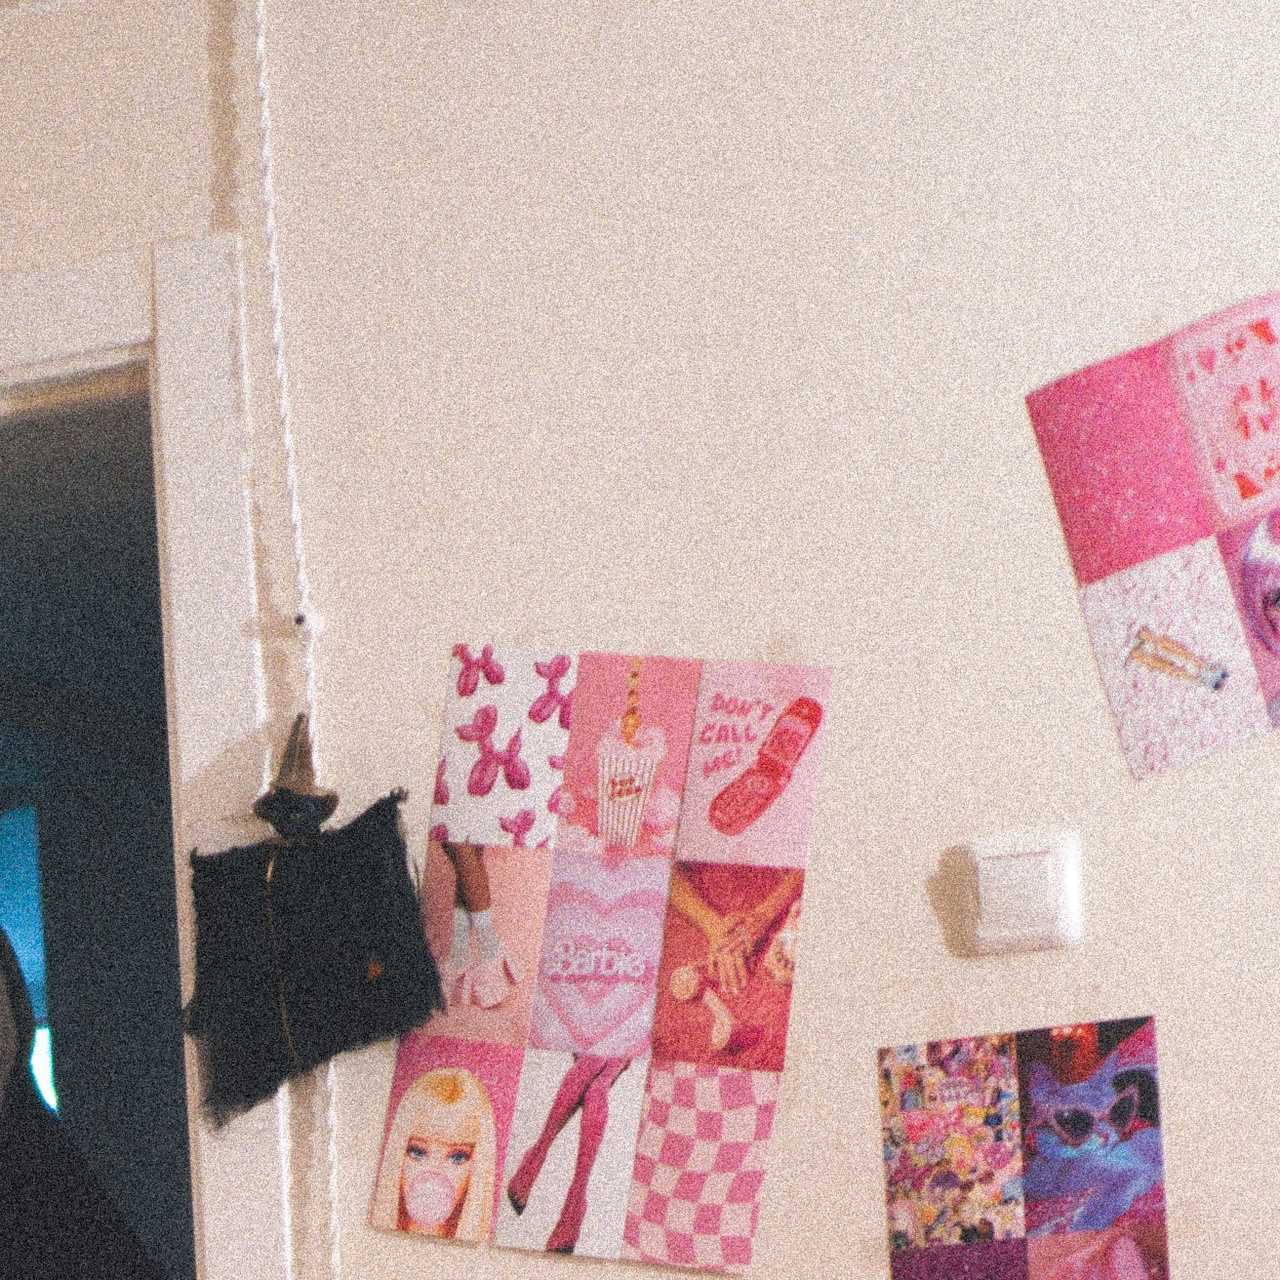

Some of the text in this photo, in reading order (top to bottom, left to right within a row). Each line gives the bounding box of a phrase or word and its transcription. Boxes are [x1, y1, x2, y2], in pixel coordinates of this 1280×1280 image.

[712, 692, 774, 721] DON'T
[700, 723, 758, 745] CALL
[703, 747, 743, 779] ME!
[550, 938, 647, 977] Barbie
